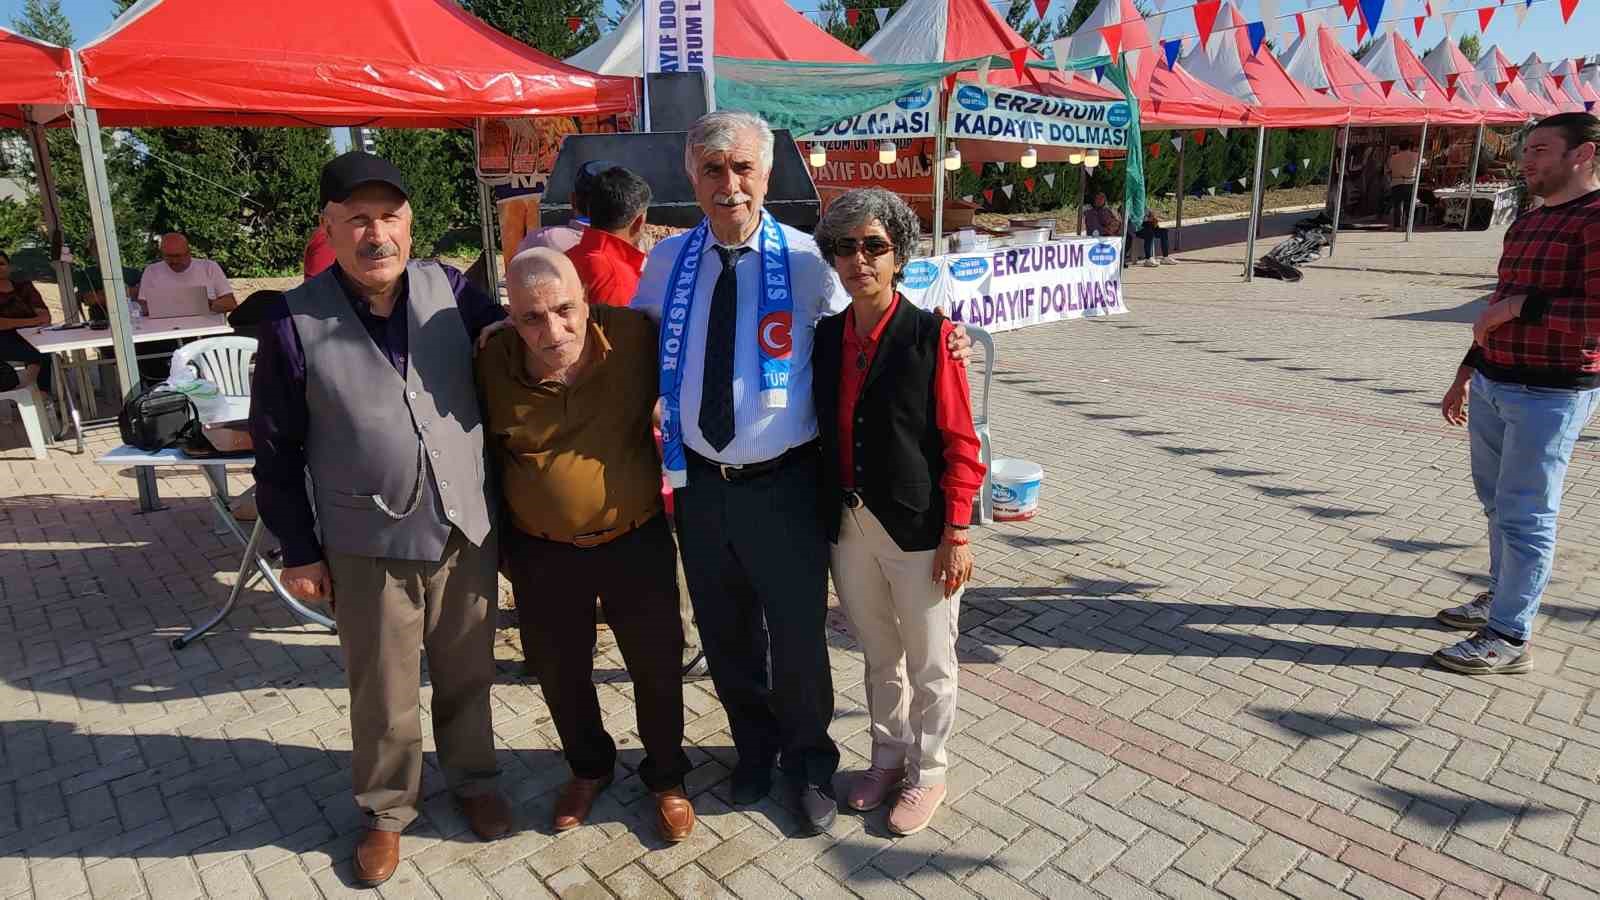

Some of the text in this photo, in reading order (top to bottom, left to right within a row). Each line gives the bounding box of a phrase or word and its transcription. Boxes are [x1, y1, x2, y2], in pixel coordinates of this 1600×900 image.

[994, 93, 1105, 121] ERZURUM
[954, 113, 1128, 146] KADAYIF DOLMASI
[993, 243, 1084, 278] ERZURUM
[951, 279, 1119, 327] KADAYIF DOLMASI
